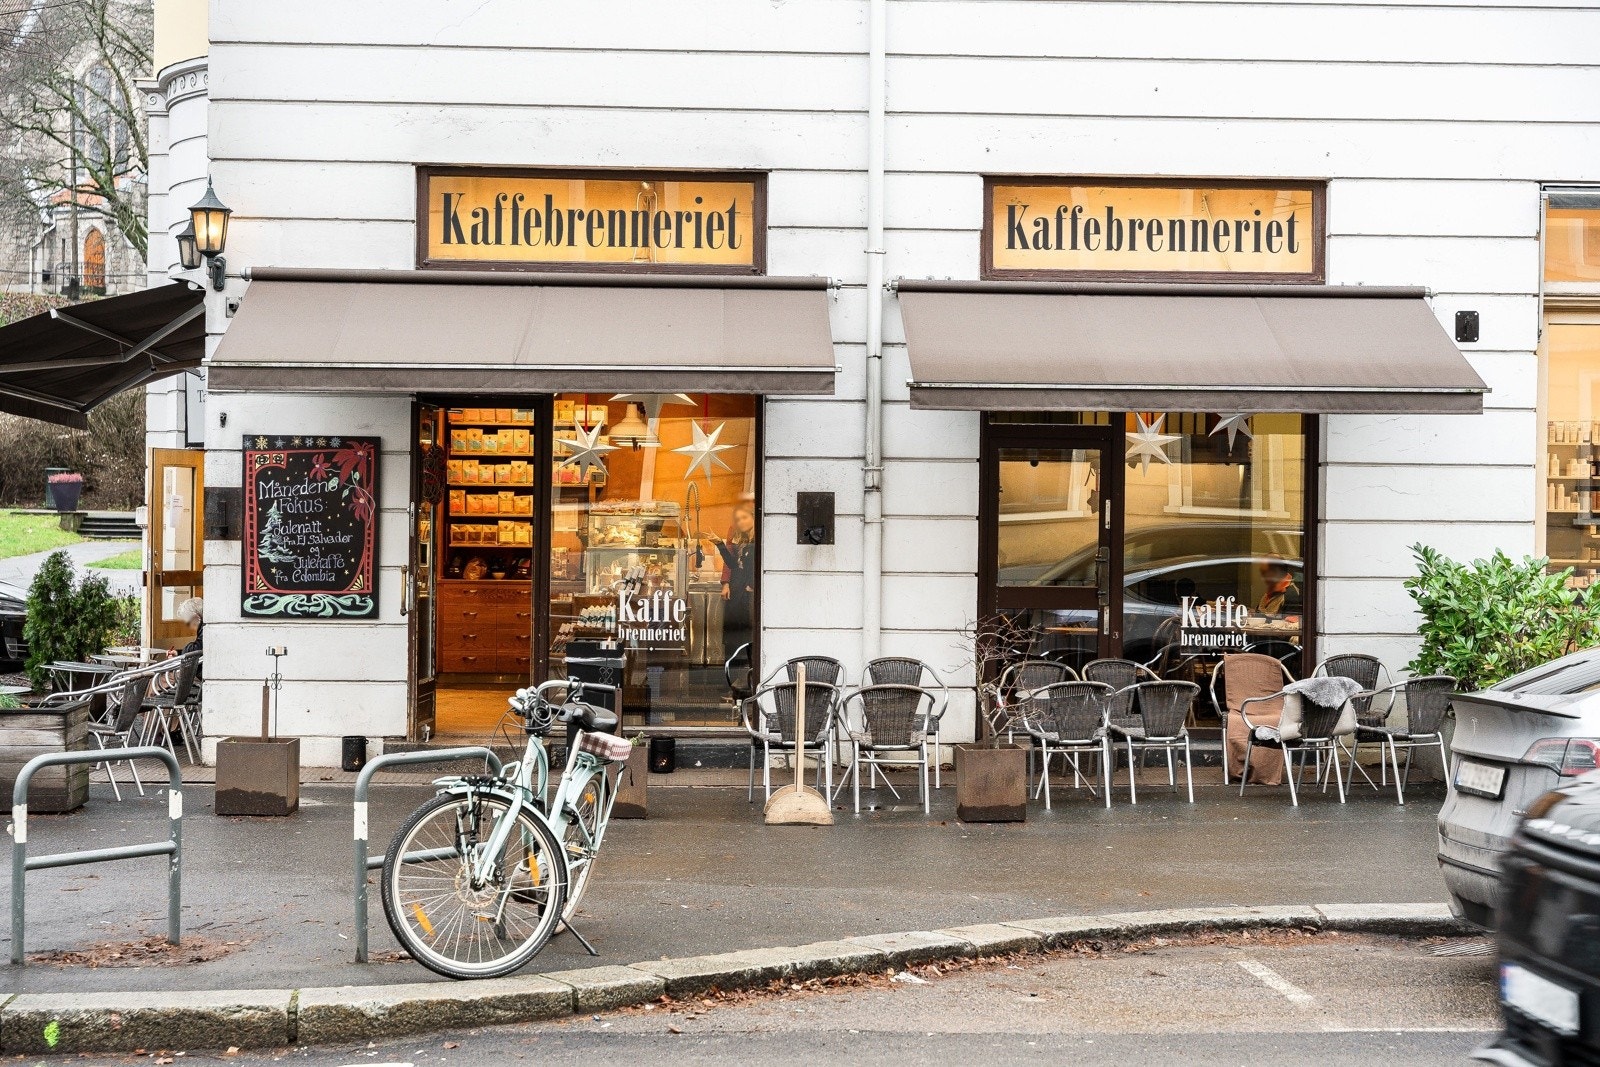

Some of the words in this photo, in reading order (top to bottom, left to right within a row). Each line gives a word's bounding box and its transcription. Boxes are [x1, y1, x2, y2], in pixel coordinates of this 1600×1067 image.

[440, 192, 743, 250] Kaffebrenneriet
[1005, 204, 1300, 254] Kaffebrenneriet
[273, 519, 322, 537] Julenatt
[283, 535, 296, 549] fra
[296, 534, 306, 546] El
[307, 530, 353, 545] Salvador
[309, 546, 320, 558] og
[293, 553, 345, 570] Julekaffe
[275, 569, 289, 585] fra
[292, 567, 336, 583] Colombia
[617, 589, 687, 623] Kaffe
[1180, 595, 1248, 628] Kaffe
[617, 624, 687, 642] brenneriet
[1180, 629, 1248, 647] brenneriet
